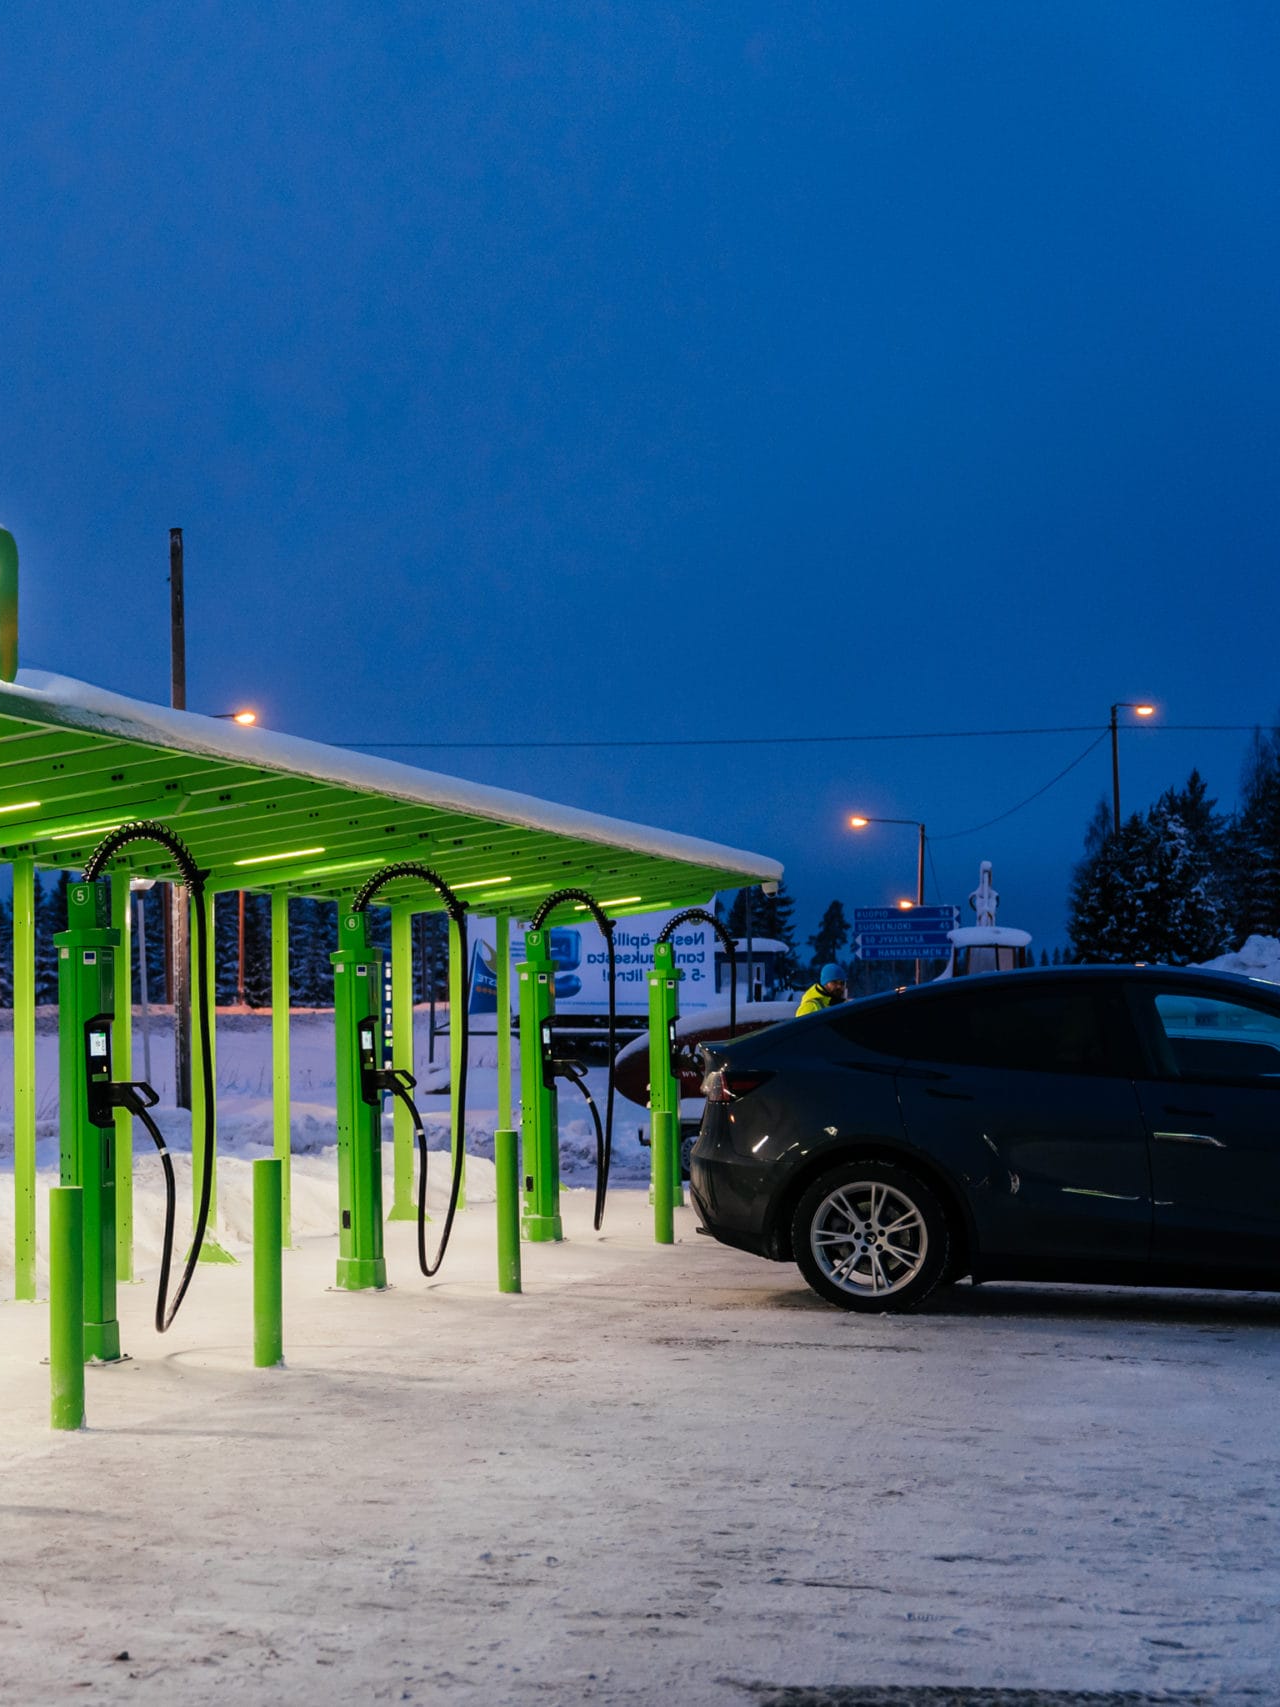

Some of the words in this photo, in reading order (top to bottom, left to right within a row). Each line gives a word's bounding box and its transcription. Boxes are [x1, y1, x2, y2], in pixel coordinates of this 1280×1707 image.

[77, 890, 85, 902] 5
[348, 918, 356, 928] 6
[531, 935, 538, 944] 7
